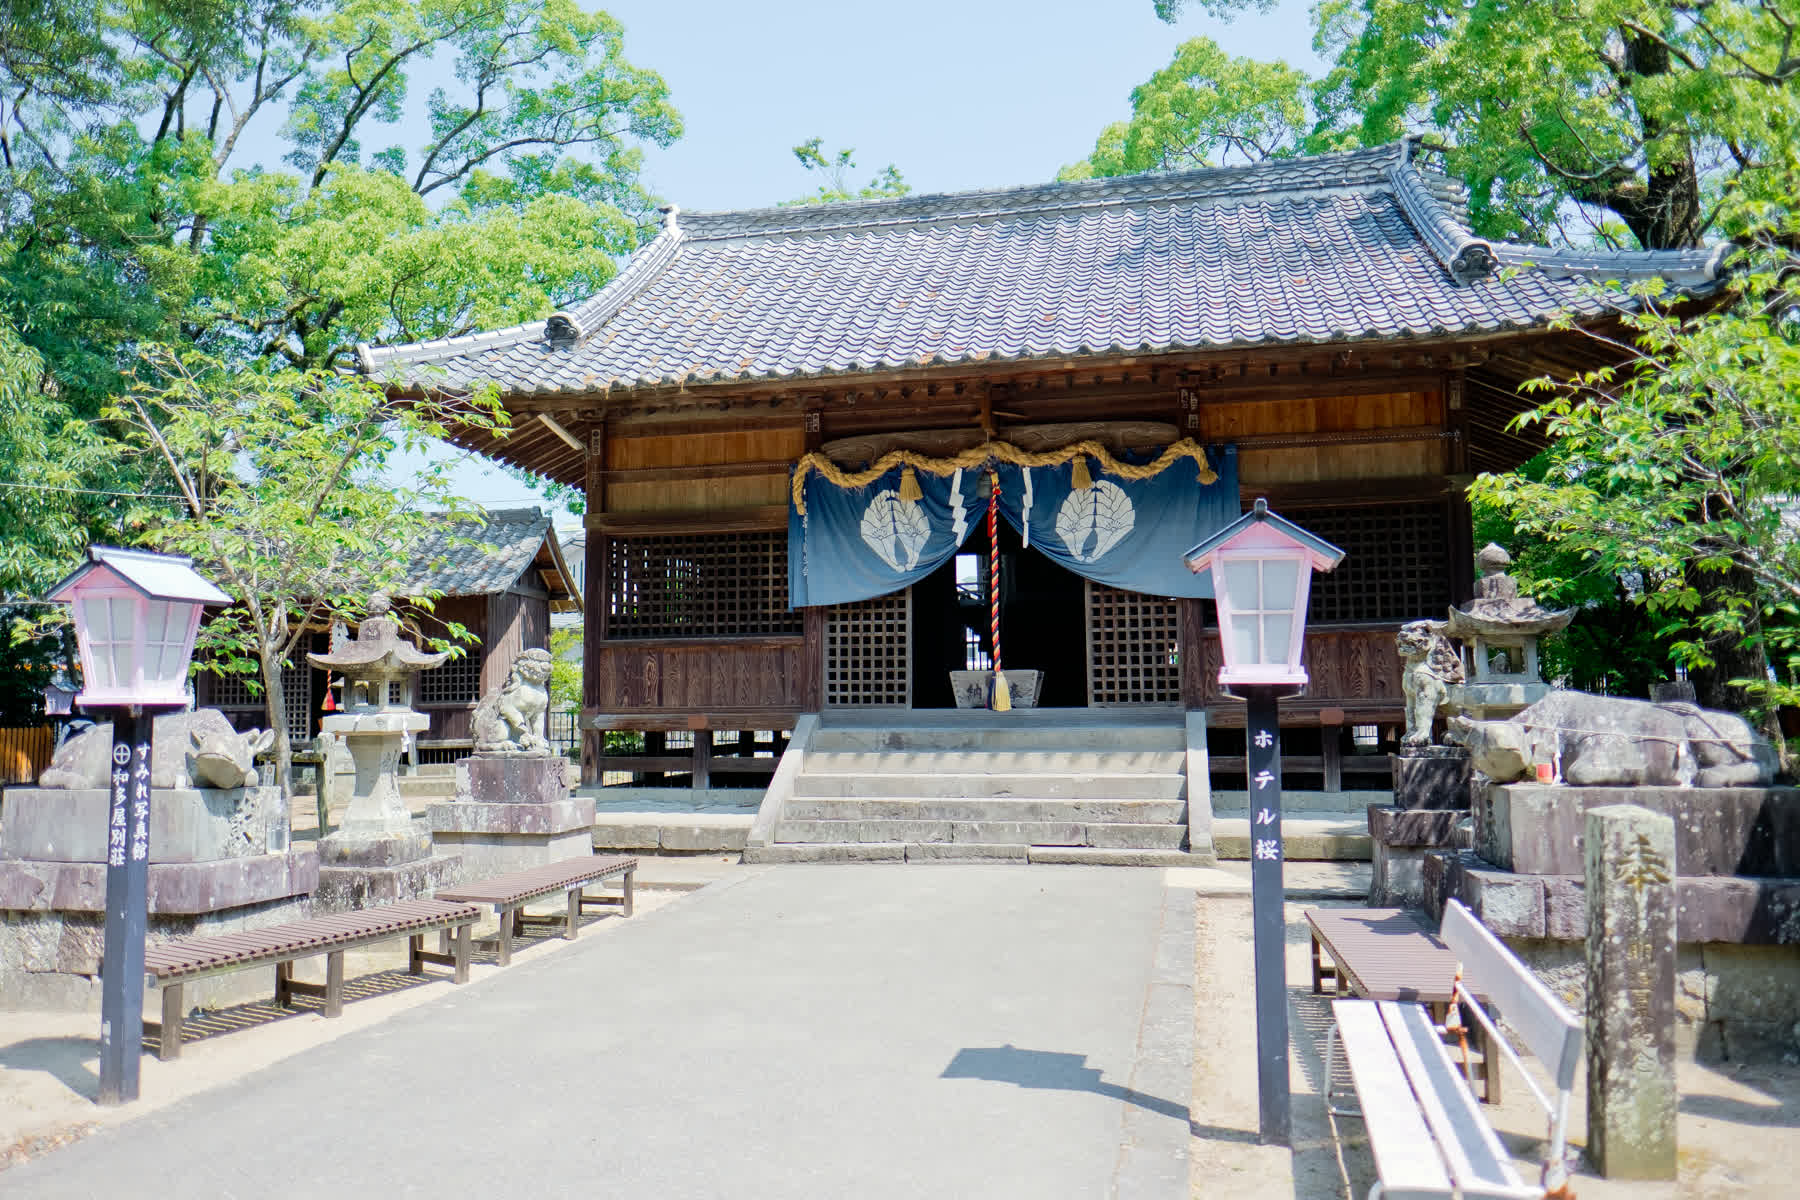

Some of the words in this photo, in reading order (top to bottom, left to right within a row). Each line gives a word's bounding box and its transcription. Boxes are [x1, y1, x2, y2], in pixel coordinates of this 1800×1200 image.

[109, 767, 130, 867] 和多屋別荘
[133, 741, 151, 861] すみれ写真館
[1254, 729, 1280, 861] ホテル桜
